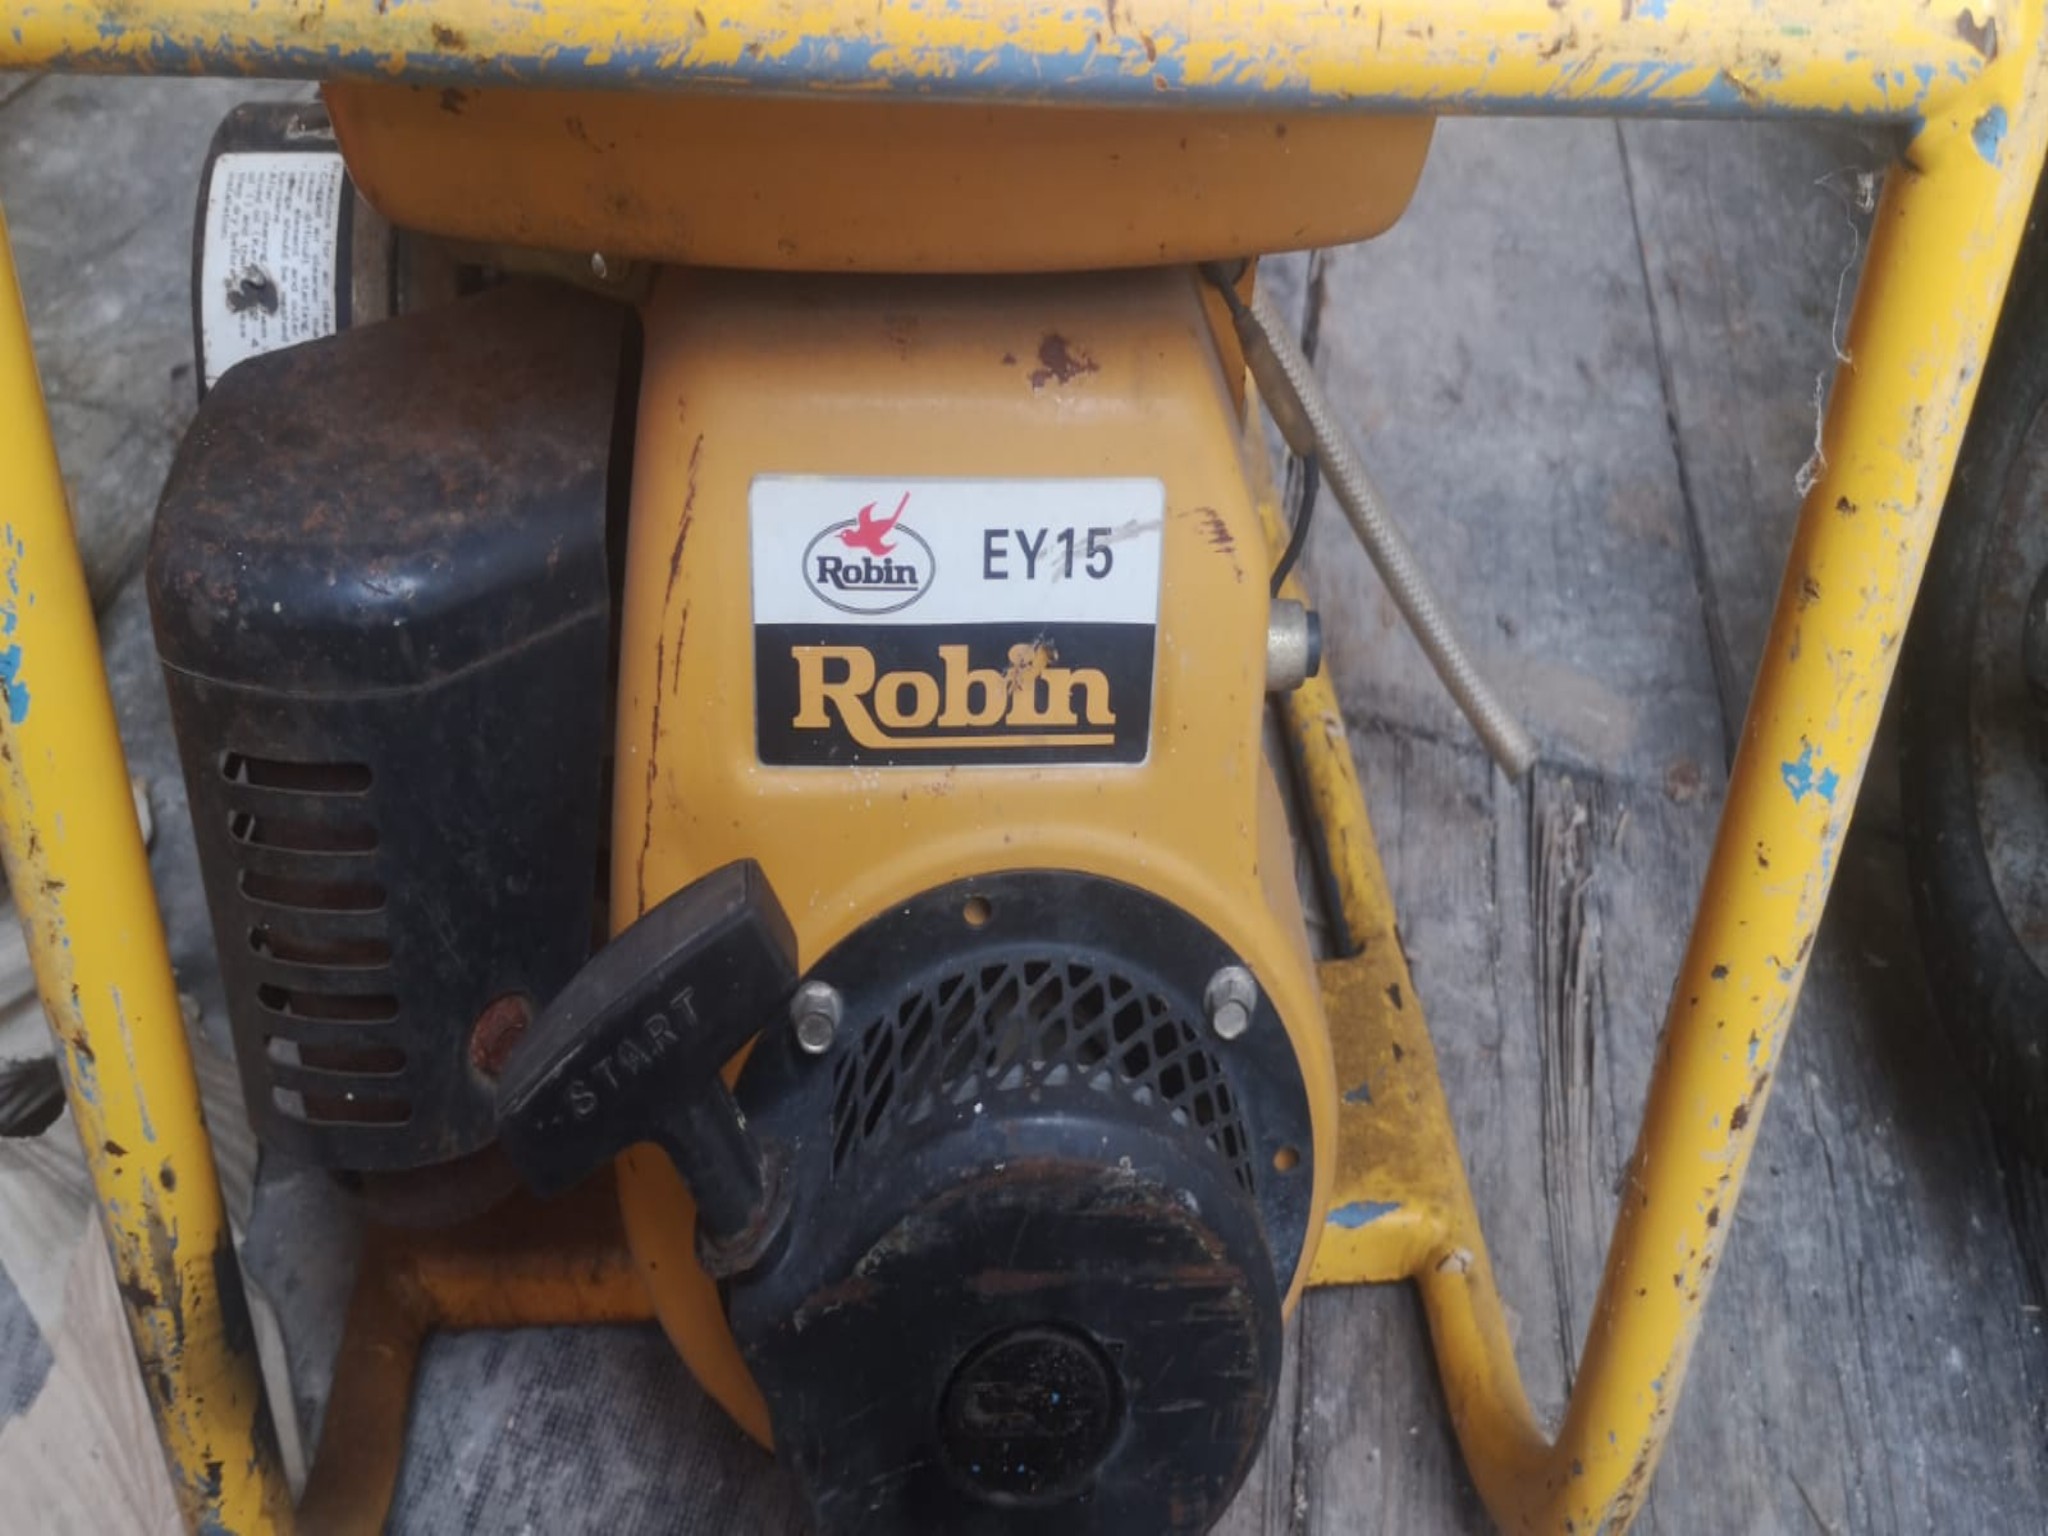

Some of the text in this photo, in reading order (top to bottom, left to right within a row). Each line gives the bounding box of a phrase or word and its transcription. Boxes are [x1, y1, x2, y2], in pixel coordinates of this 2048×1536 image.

[816, 555, 919, 591] Robin
[982, 526, 1114, 581] EY15
[791, 643, 1117, 749] Robin
[570, 985, 699, 1115] START
